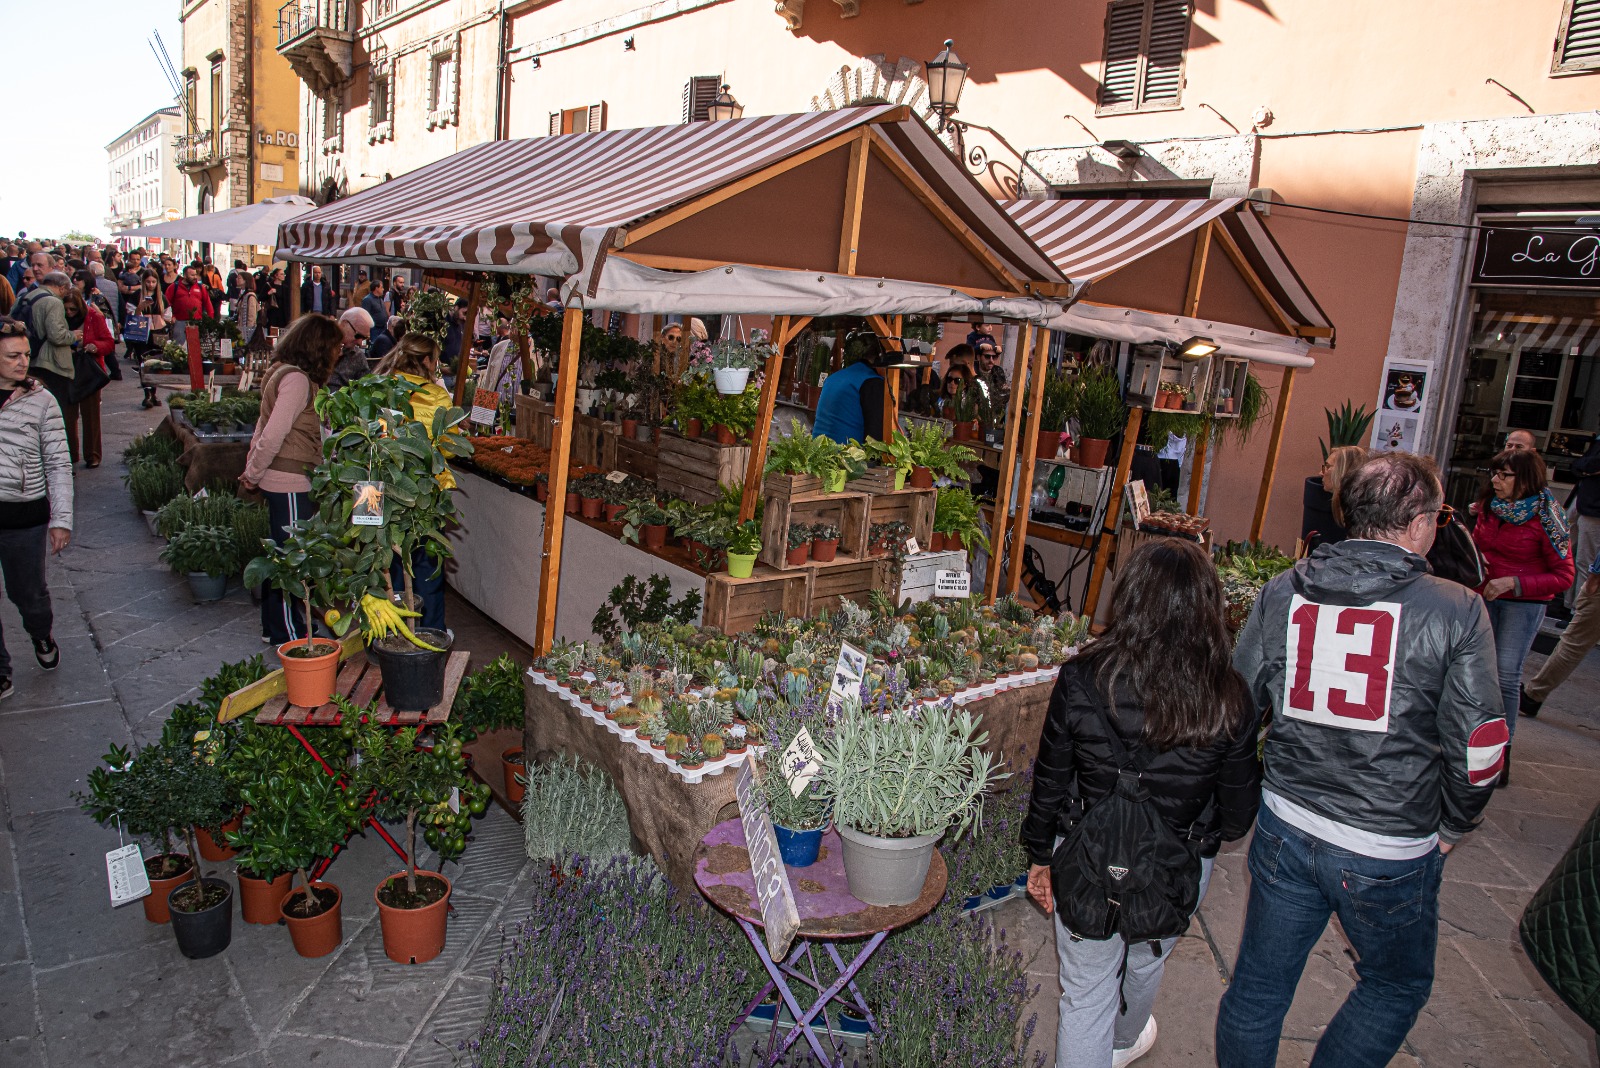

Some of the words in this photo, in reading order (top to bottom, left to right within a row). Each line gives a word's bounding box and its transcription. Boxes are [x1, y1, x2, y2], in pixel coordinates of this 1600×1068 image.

[258, 133, 273, 145] LA
[276, 130, 299, 148] RO
[1511, 235, 1561, 263] La
[1567, 235, 1600, 276] G
[1289, 604, 1395, 722] 13
